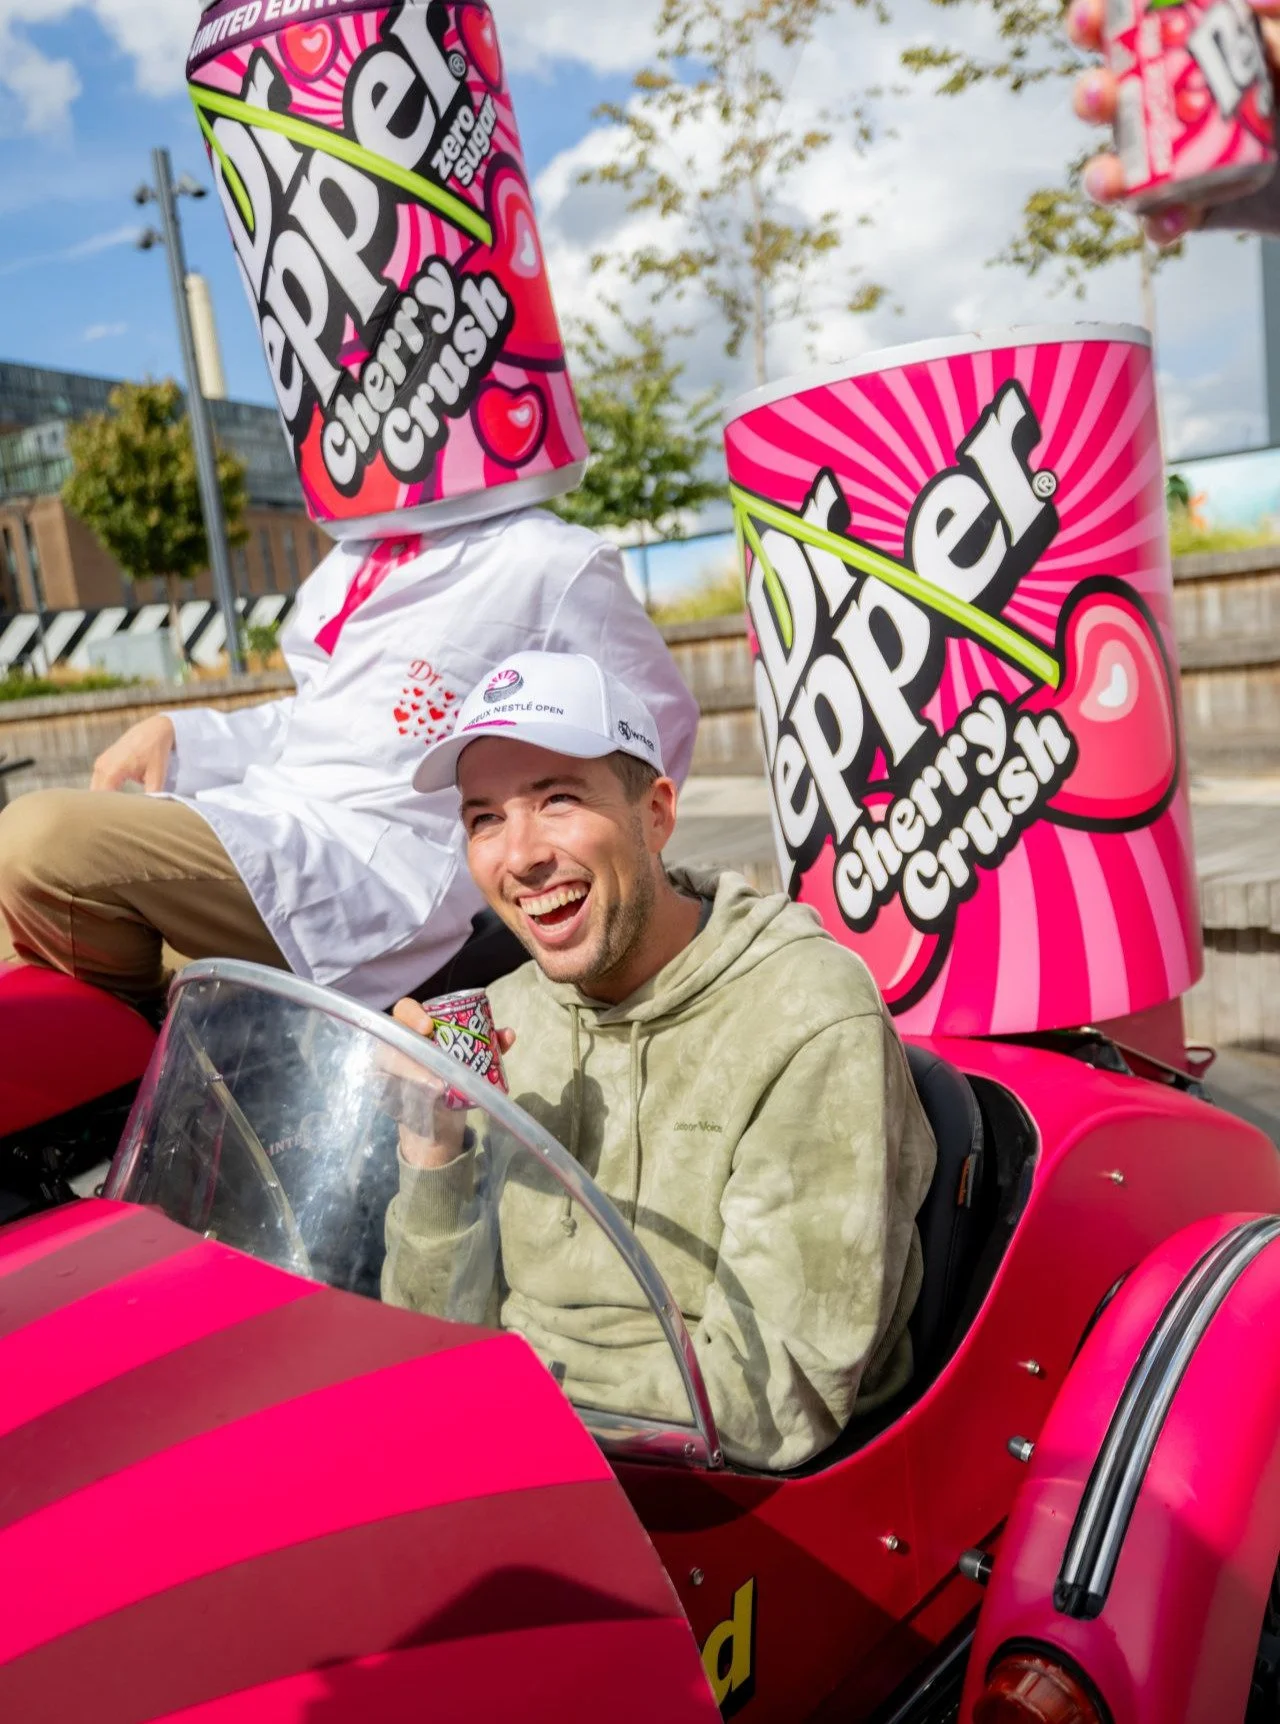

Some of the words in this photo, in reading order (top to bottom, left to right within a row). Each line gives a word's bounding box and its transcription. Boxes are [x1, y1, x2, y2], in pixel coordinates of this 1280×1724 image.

[430, 105, 475, 180] zero
[453, 94, 497, 187] sugar
[324, 260, 455, 485] cherry
[407, 659, 443, 686] Dr
[493, 701, 533, 714] NESTLÉ
[535, 704, 564, 715] OPEN
[837, 697, 1006, 920] cherry
